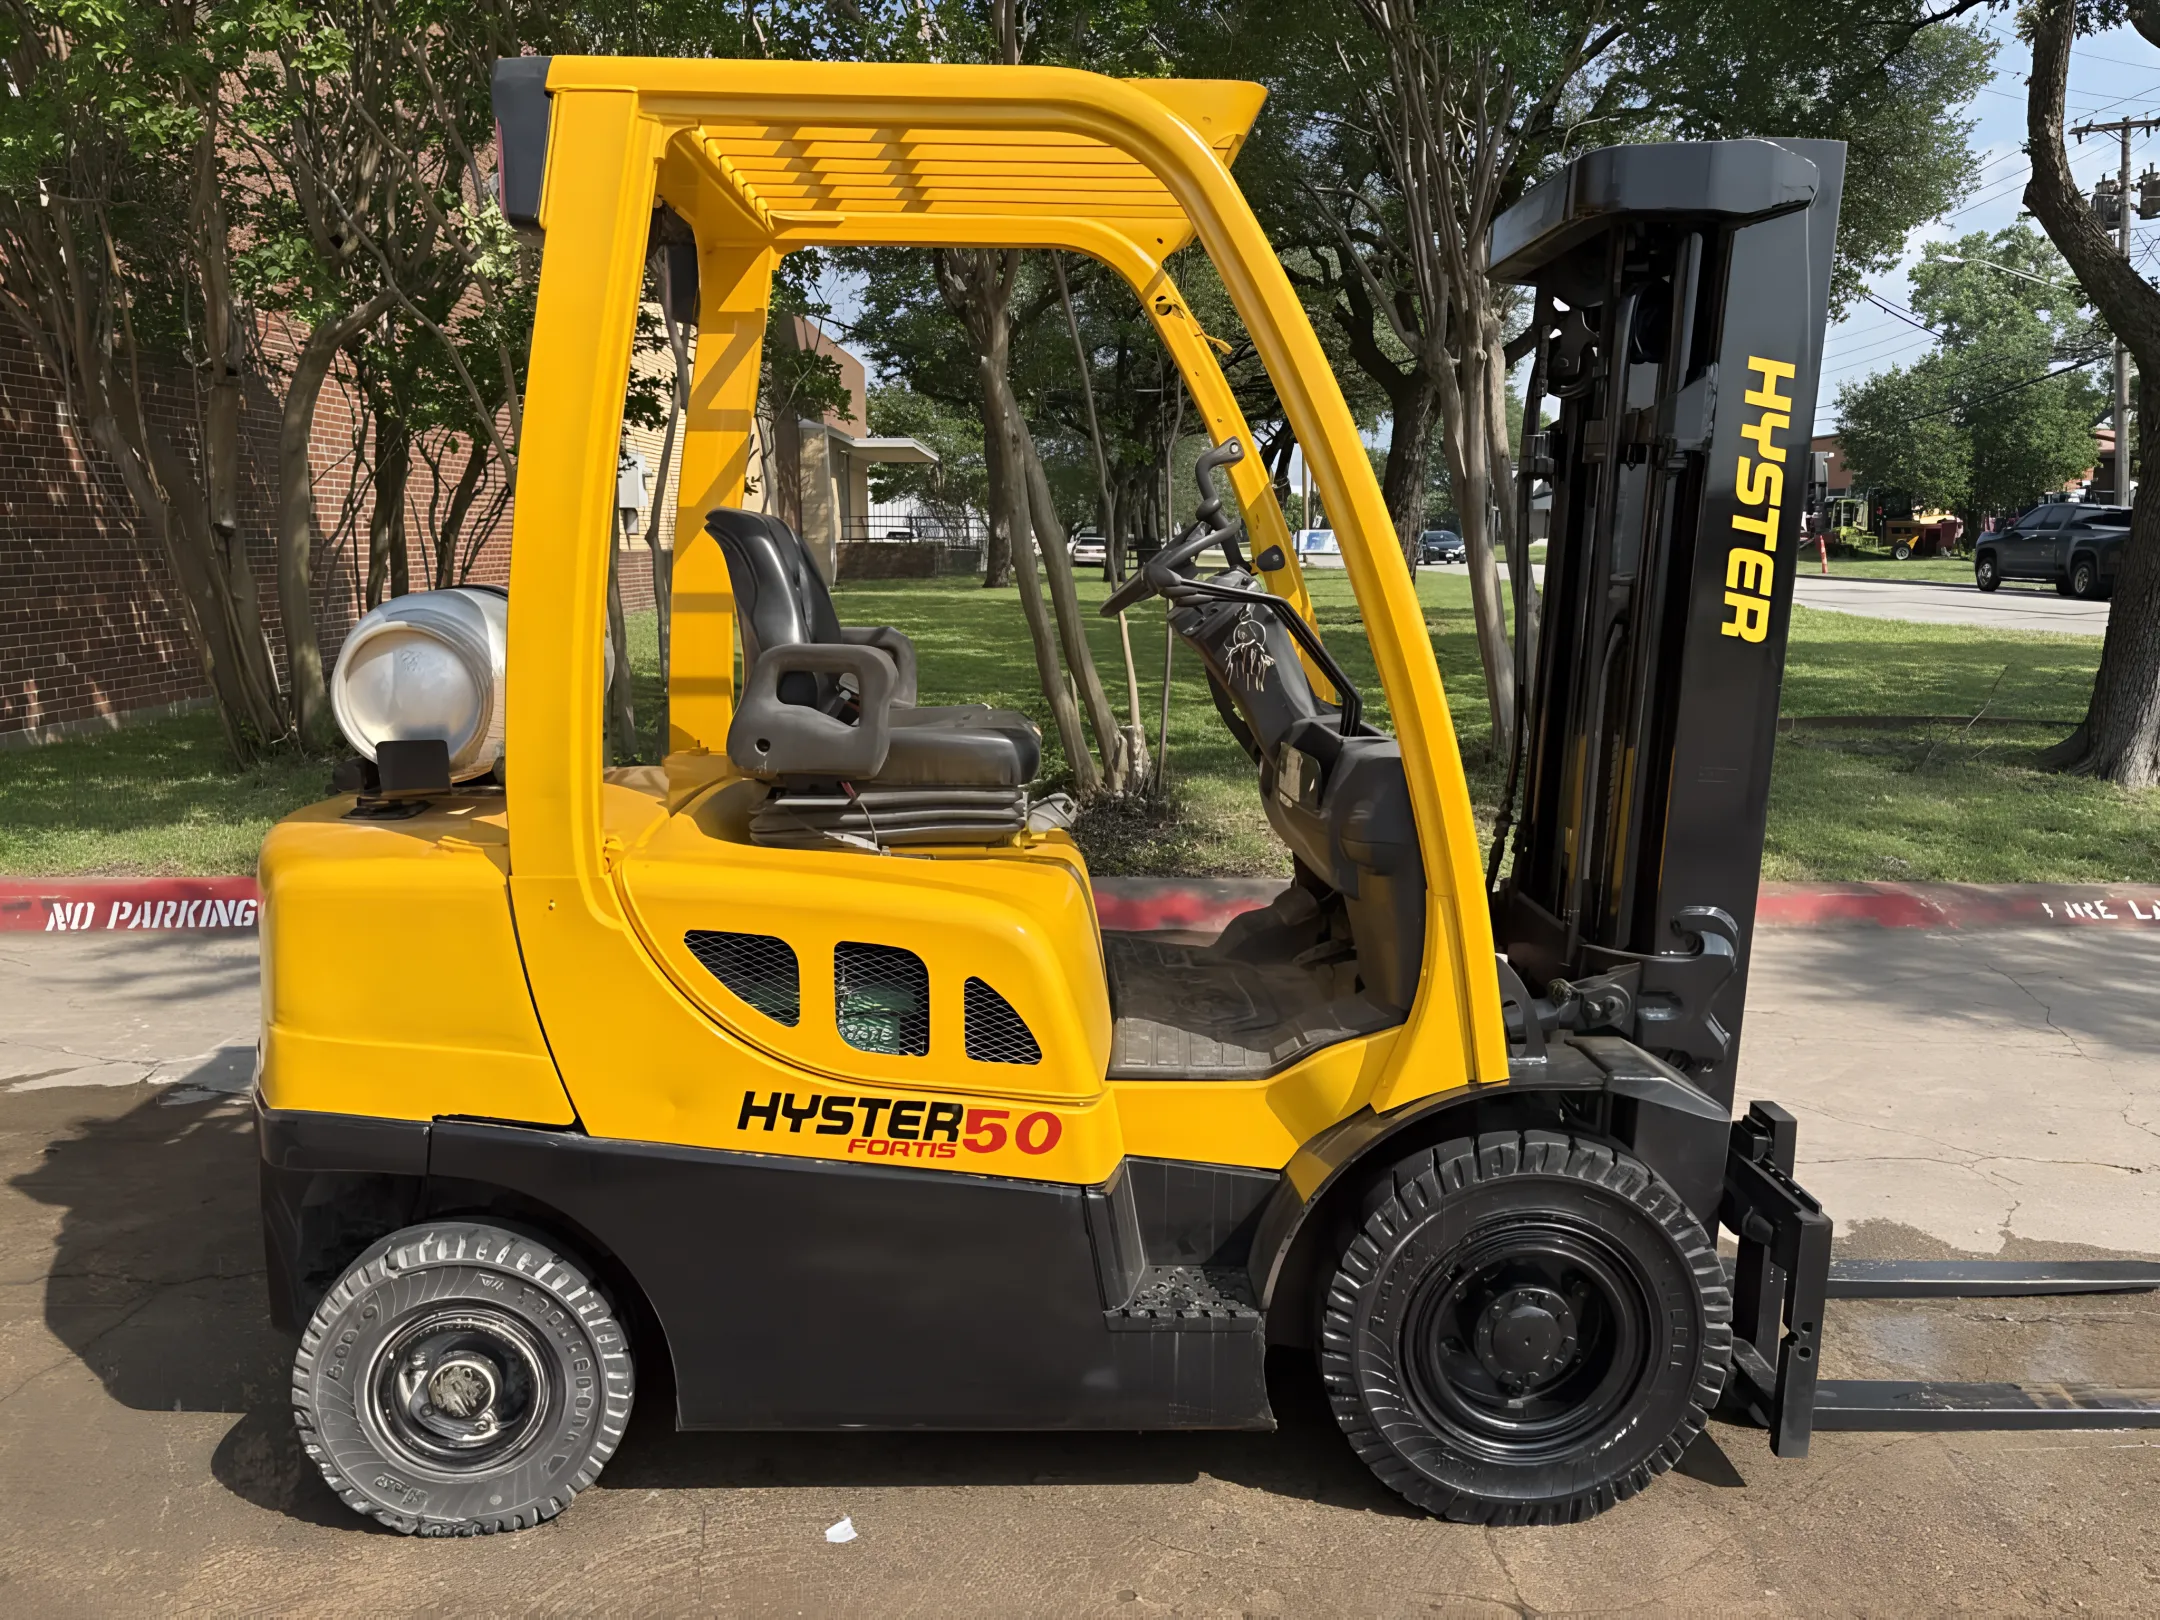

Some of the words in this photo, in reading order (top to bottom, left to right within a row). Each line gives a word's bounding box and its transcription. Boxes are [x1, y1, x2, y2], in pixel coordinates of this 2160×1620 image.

[1721, 355, 1796, 644] HYSTER
[45, 902, 96, 931] NO
[107, 899, 258, 929] PARKING
[737, 1090, 964, 1143] HYSTER
[963, 1108, 1063, 1155] 50
[847, 1138, 957, 1159] FORTIS
